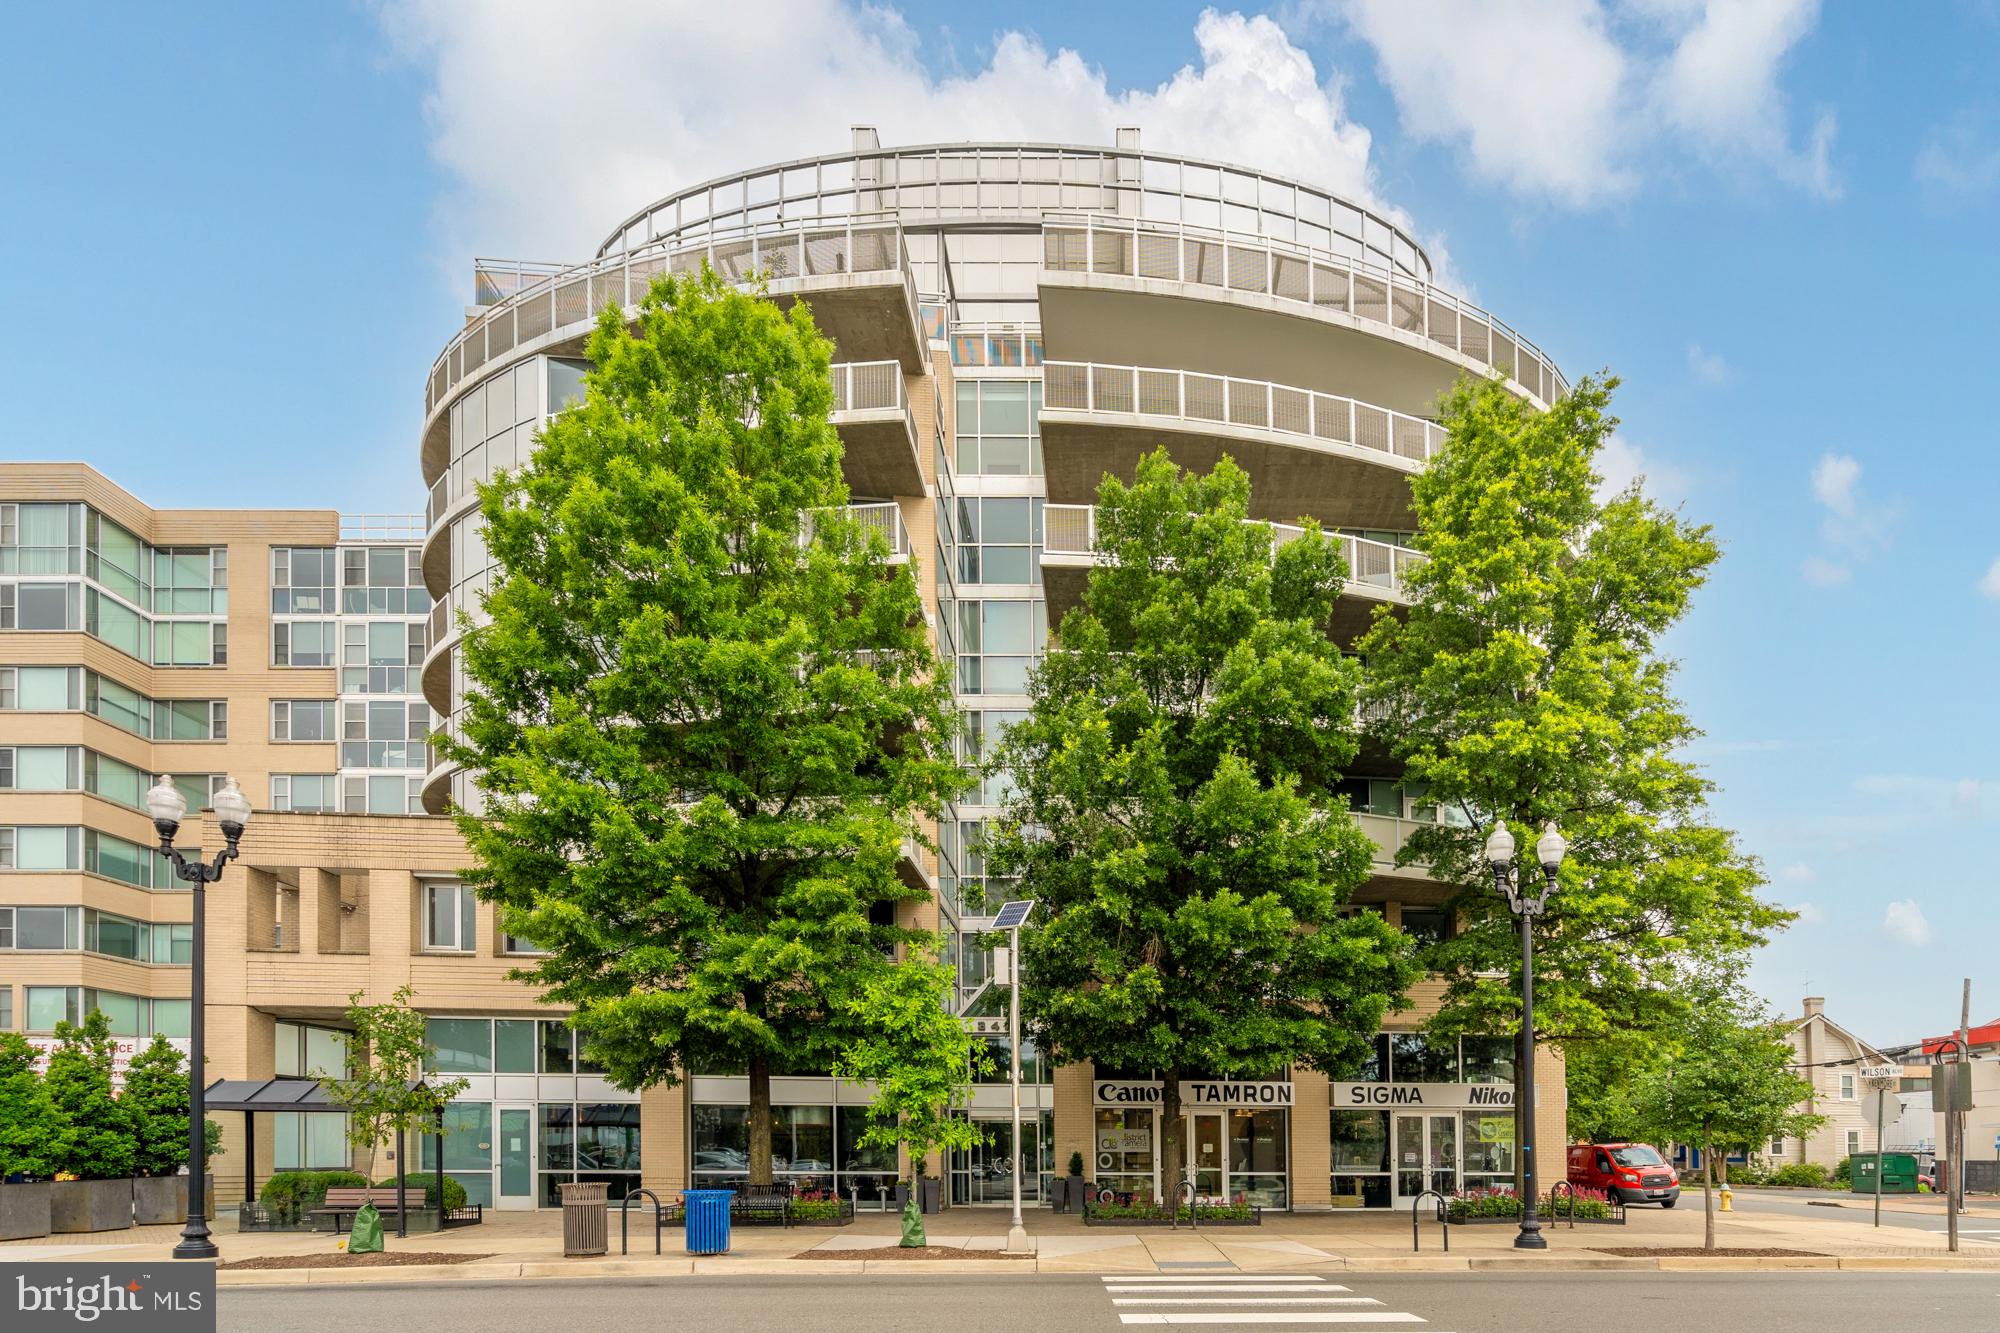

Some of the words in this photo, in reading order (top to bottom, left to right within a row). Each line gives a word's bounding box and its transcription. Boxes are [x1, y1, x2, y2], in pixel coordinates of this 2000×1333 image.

[1861, 1068, 1890, 1077] WILSON
[1191, 1084, 1291, 1103] TAMRON
[1351, 1086, 1423, 1104] SIGMA
